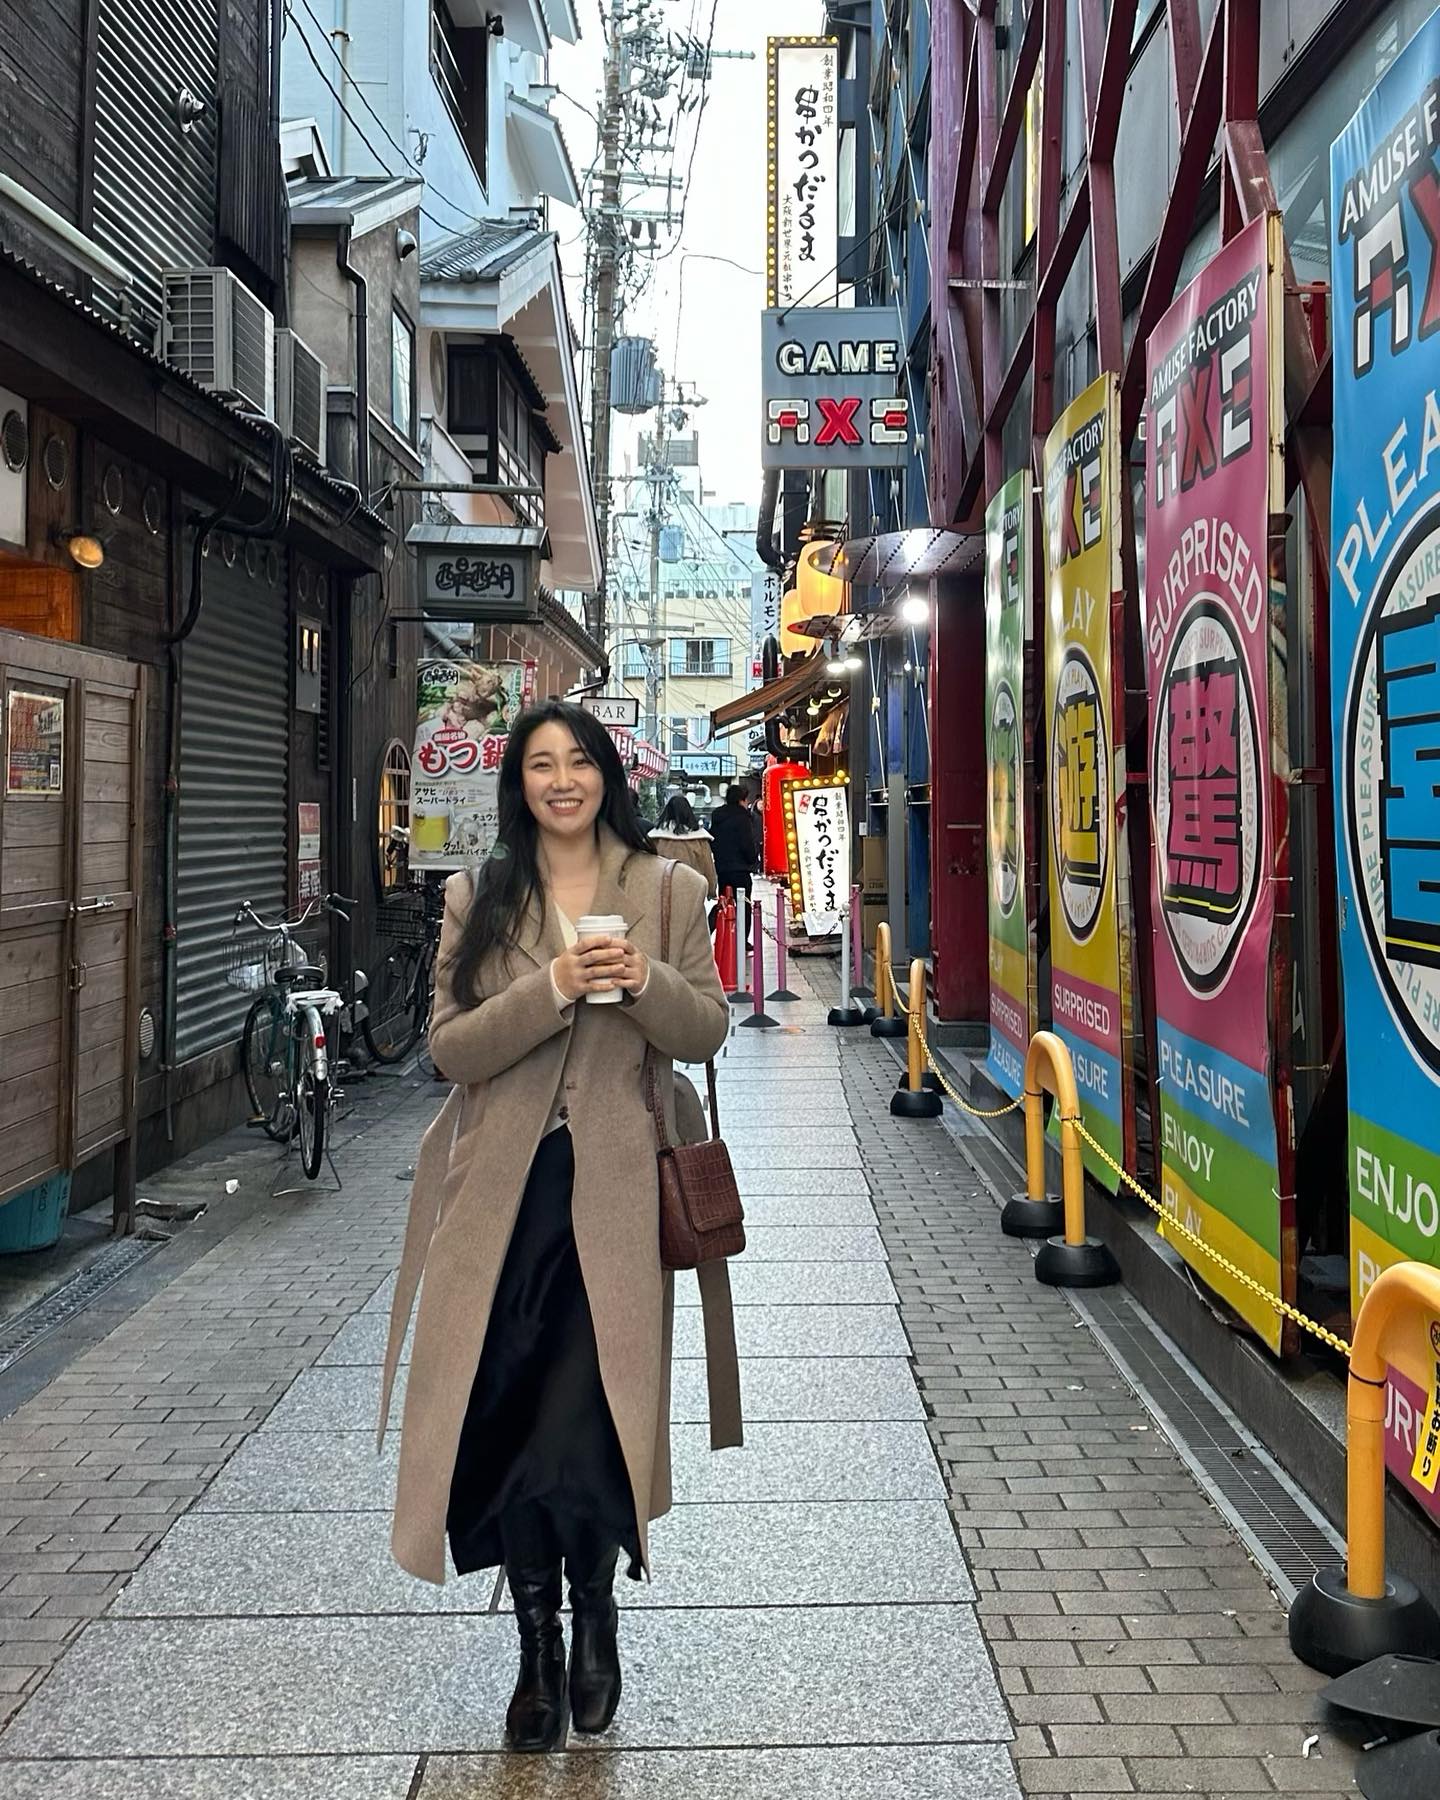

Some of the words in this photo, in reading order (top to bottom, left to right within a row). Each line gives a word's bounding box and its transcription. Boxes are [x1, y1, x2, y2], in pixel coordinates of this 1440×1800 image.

[793, 84, 826, 262] 串かつだるま
[1342, 115, 1420, 235] AMUSE
[777, 342, 900, 376] GAME
[1151, 344, 1187, 404] AMUSE
[1187, 273, 1261, 360] FACTORY
[767, 398, 909, 445] AXE
[1062, 414, 1106, 470] FACTORY
[1156, 334, 1252, 502] AXE
[764, 576, 776, 632] ホルモン
[1149, 517, 1263, 669] SURPRISED
[592, 705, 625, 719] BAR
[414, 787, 436, 796] アサヒ
[813, 794, 839, 912] 串かつだるま
[990, 991, 1023, 1039] SURPRISED
[1053, 983, 1111, 1036] SURPRISED
[989, 1038, 1022, 1088] PLEASURE
[1160, 1039, 1250, 1128] PLEASURE
[1164, 1111, 1214, 1183] ENJOY
